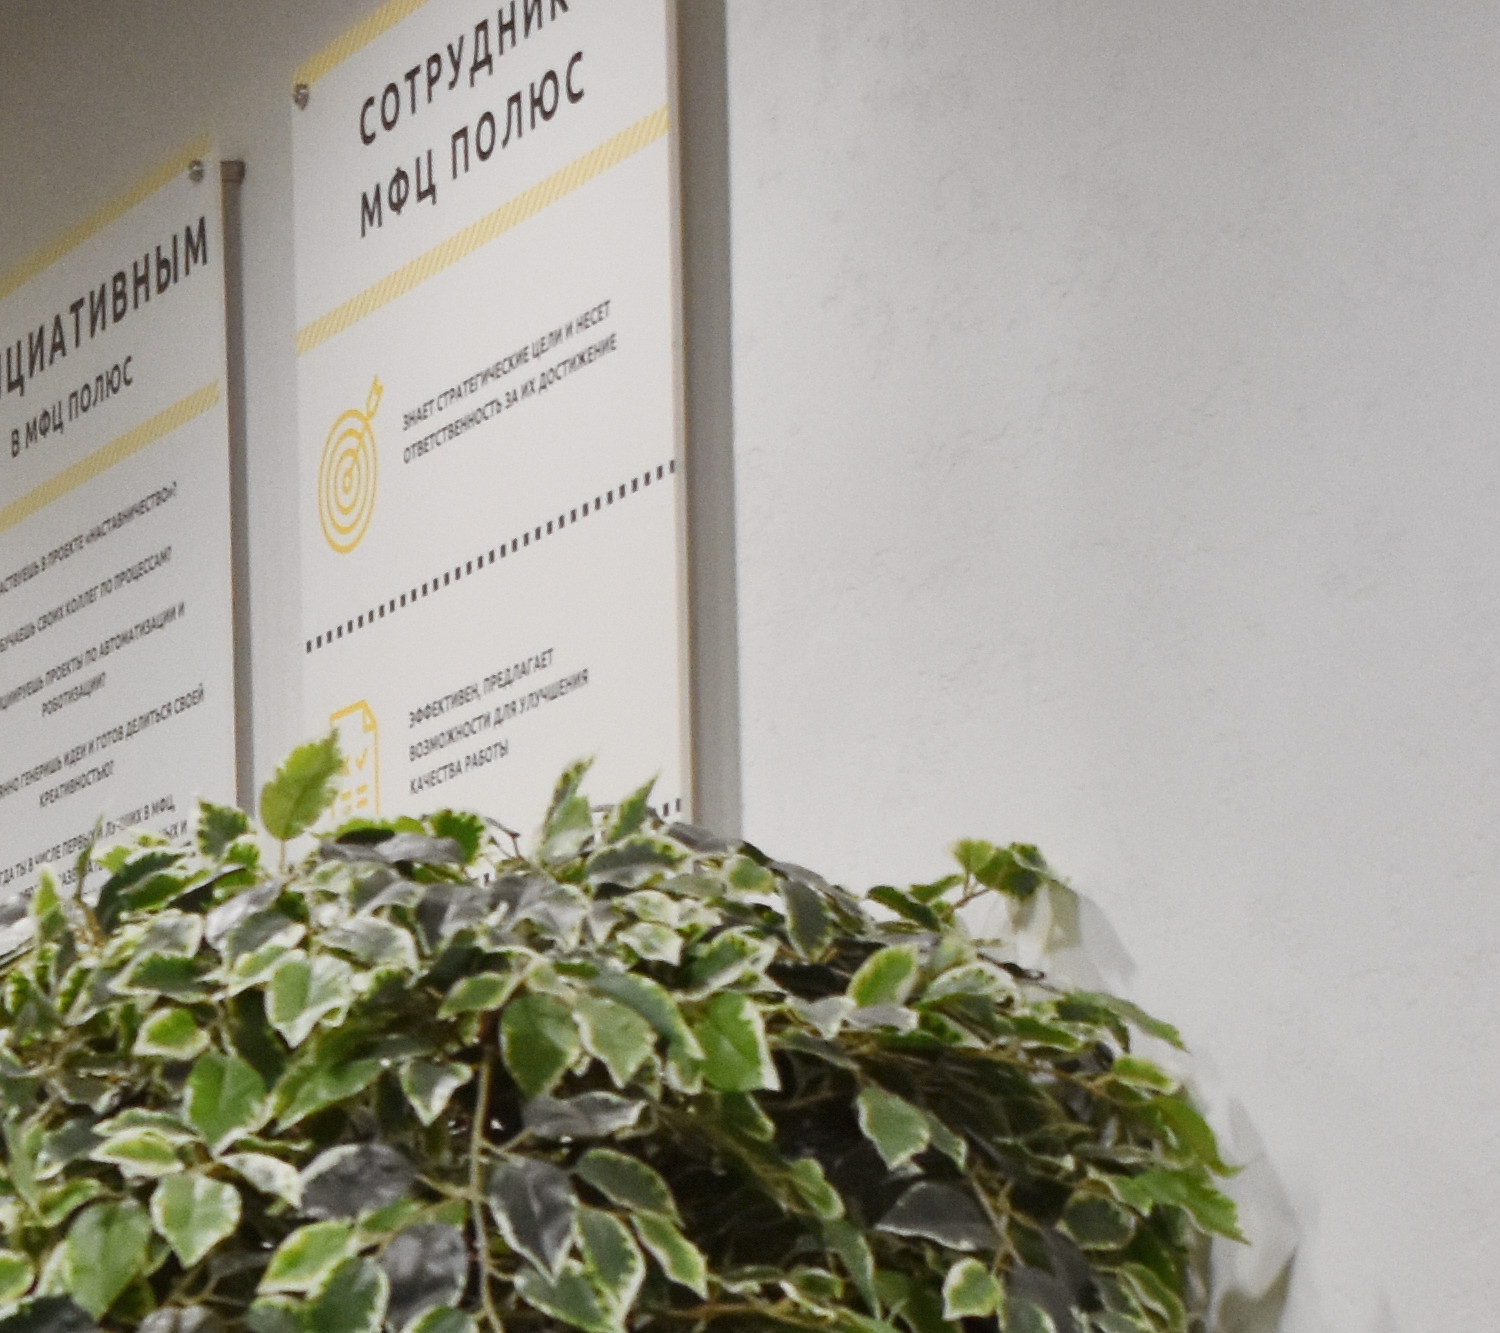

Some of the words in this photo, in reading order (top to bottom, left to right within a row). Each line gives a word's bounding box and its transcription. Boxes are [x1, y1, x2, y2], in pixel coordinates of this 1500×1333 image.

[360, 144, 436, 245] МФЦ
[450, 49, 584, 182] ПОЛЮС
[10, 427, 18, 459] В
[25, 398, 64, 453] МФЦ
[68, 353, 132, 422] ПОЛЮС
[403, 397, 434, 431] ЗНАЕТ
[436, 344, 529, 413] СТРАТЕГИЧЕСКИЕ
[532, 326, 561, 360] ЦЕЛИ
[565, 320, 572, 341] И
[577, 299, 610, 335] НЕСЕТ
[403, 394, 502, 465] ОТВЕТСТВЕННОСТЬ
[505, 386, 518, 410] ЗА
[520, 376, 534, 402] ИХ
[539, 332, 617, 392] ДОСТИЖЕНИЕ
[37, 604, 62, 632] СВОИХ
[66, 584, 98, 616] КОЛЛЕГ
[100, 577, 111, 598] ПО
[114, 544, 171, 590] ПРОЦЕССАМ?
[41, 556, 45, 572] В
[48, 534, 83, 568] ПРОЕКТЕ
[45, 655, 82, 688] ПРОЕКТЫ
[85, 647, 96, 667] ПО
[99, 606, 175, 659] АВТОМАТИЗАЦИИ
[178, 601, 184, 619] И
[409, 680, 480, 728] ЭФФЕКТИВЕН,
[483, 647, 553, 695] ПРЕДЛАГАЕТ
[20, 756, 60, 789] ГЕНЕРИШЬ
[64, 744, 86, 768] ИДЕИ
[88, 740, 93, 756] И
[96, 726, 123, 752] ГОТОВ
[125, 702, 171, 738] ДЕЛИТЬСЯ
[174, 683, 203, 715] СВОЕЙ
[409, 711, 490, 762] ВОЗМОЖНОСТИ
[493, 699, 516, 726] ДЛЯ
[519, 668, 587, 714] УЛУЧШЕНИЯ
[410, 757, 462, 796] КАЧЕСТВА
[465, 737, 509, 773] РАБОТЫ
[16, 860, 26, 877] ТЫ
[28, 857, 32, 872] В
[35, 845, 60, 869] ЧИСЛЕ
[144, 805, 148, 820] В
[151, 793, 175, 818] МФЦ,
